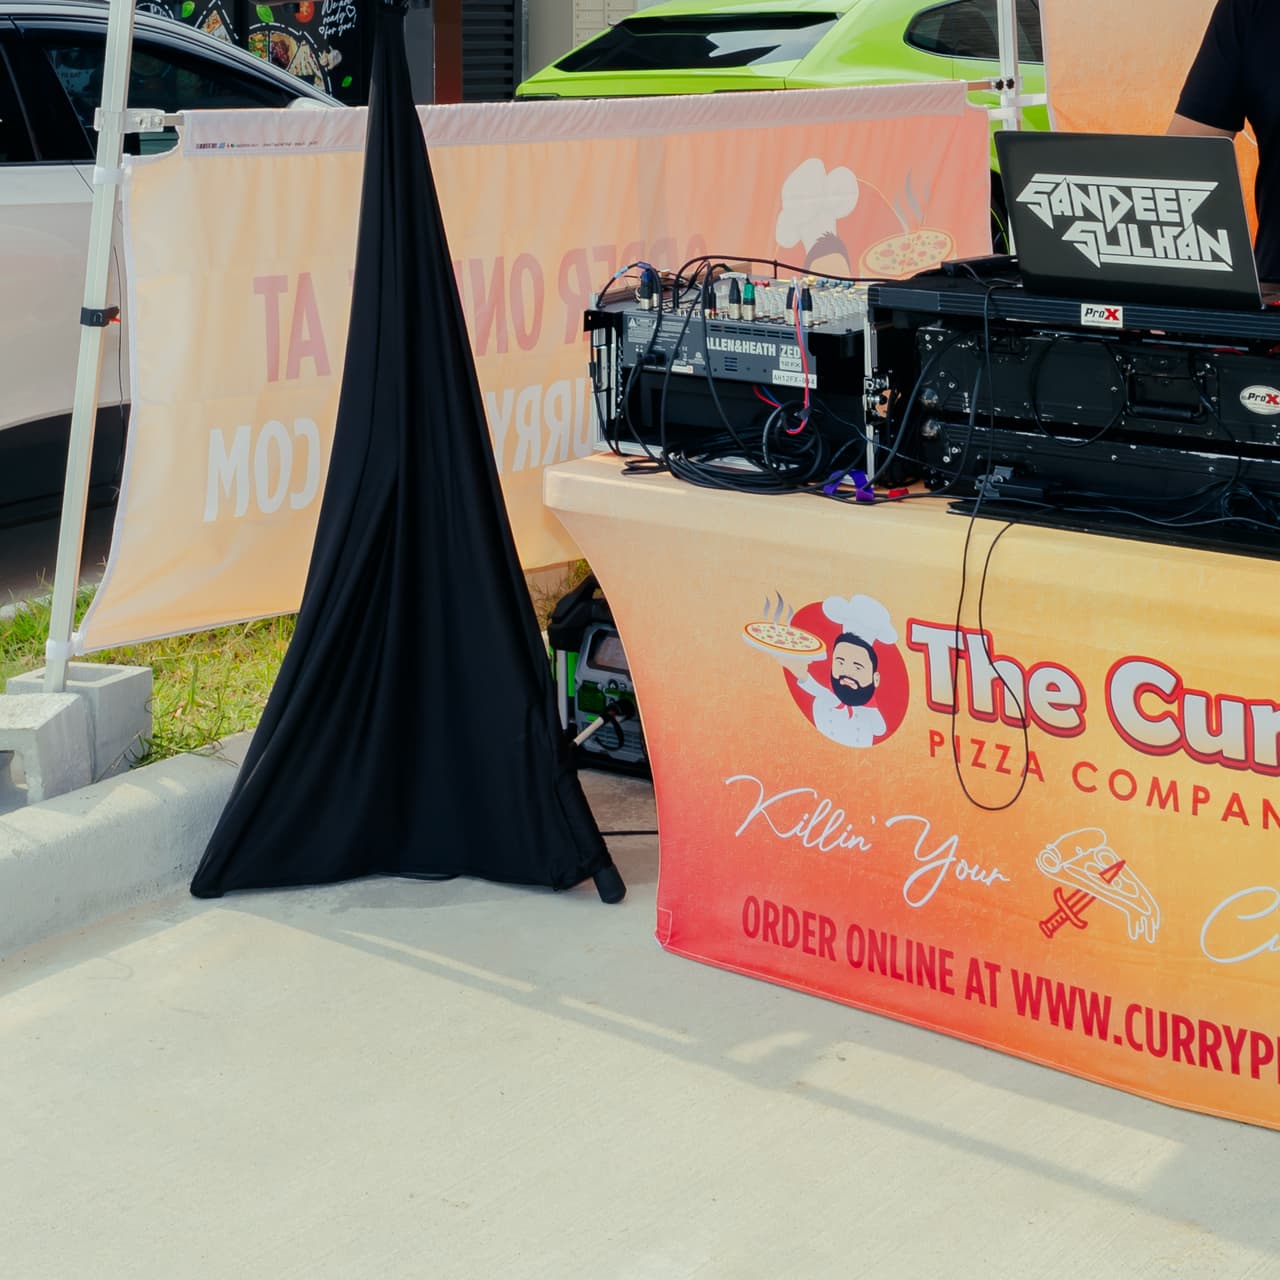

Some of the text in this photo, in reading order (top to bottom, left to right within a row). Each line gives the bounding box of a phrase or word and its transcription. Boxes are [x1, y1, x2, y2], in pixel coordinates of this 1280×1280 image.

[1015, 173, 1220, 234] SANDEEP
[1084, 306, 1120, 321] ProX
[1247, 391, 1280, 406] ProX
[906, 617, 1087, 738] The
[929, 728, 1047, 784] PIZZA
[886, 814, 1011, 908] Your
[742, 894, 838, 960] ORDER
[845, 922, 957, 1000] ONLINE
[963, 954, 1002, 1006] AT
